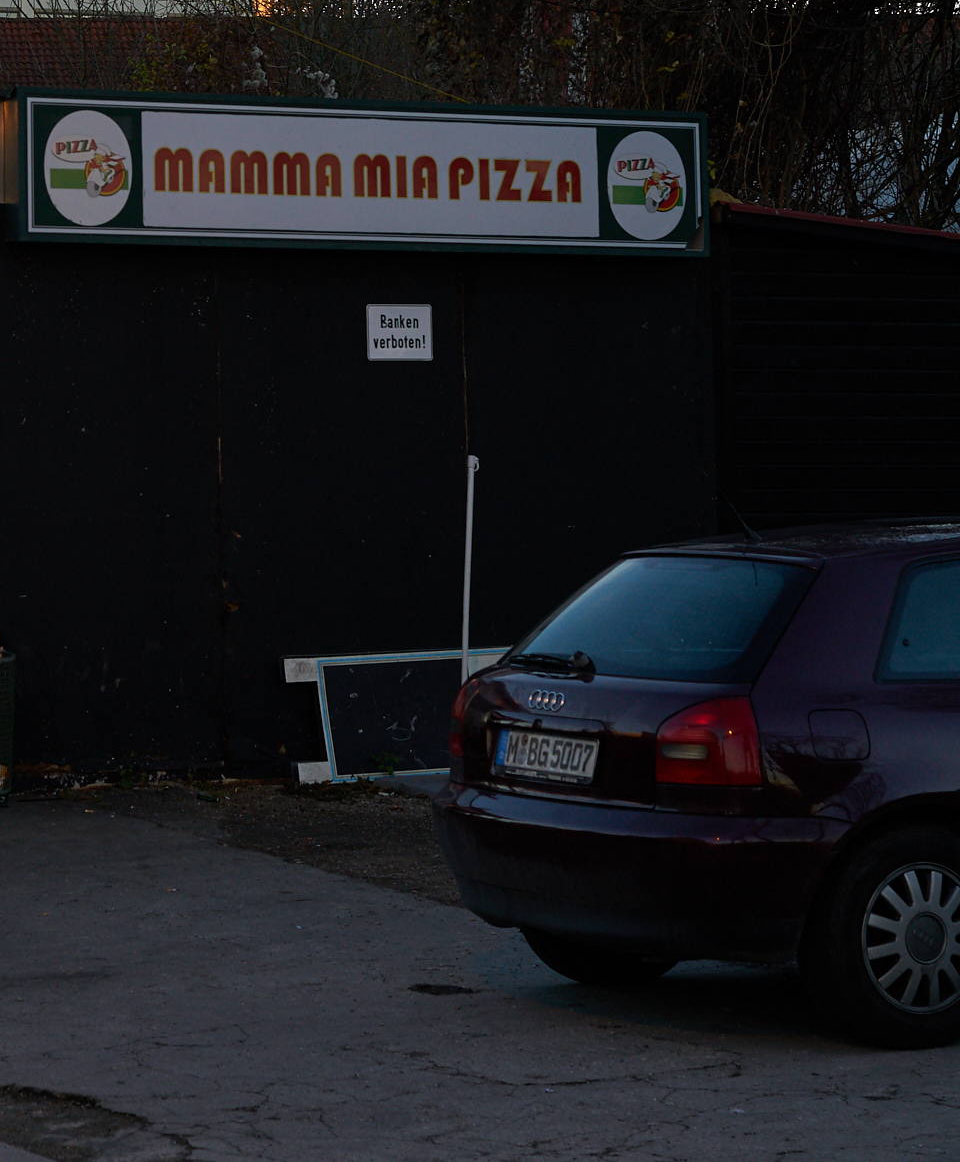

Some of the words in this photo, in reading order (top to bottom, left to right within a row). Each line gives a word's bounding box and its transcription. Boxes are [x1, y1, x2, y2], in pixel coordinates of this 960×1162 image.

[55, 139, 97, 155] PIZZA
[617, 157, 655, 173] PIZZA
[154, 147, 342, 197] MAMMA
[354, 153, 438, 199] MIA
[449, 157, 582, 203] PIZZA
[373, 334, 426, 349] verboten!
